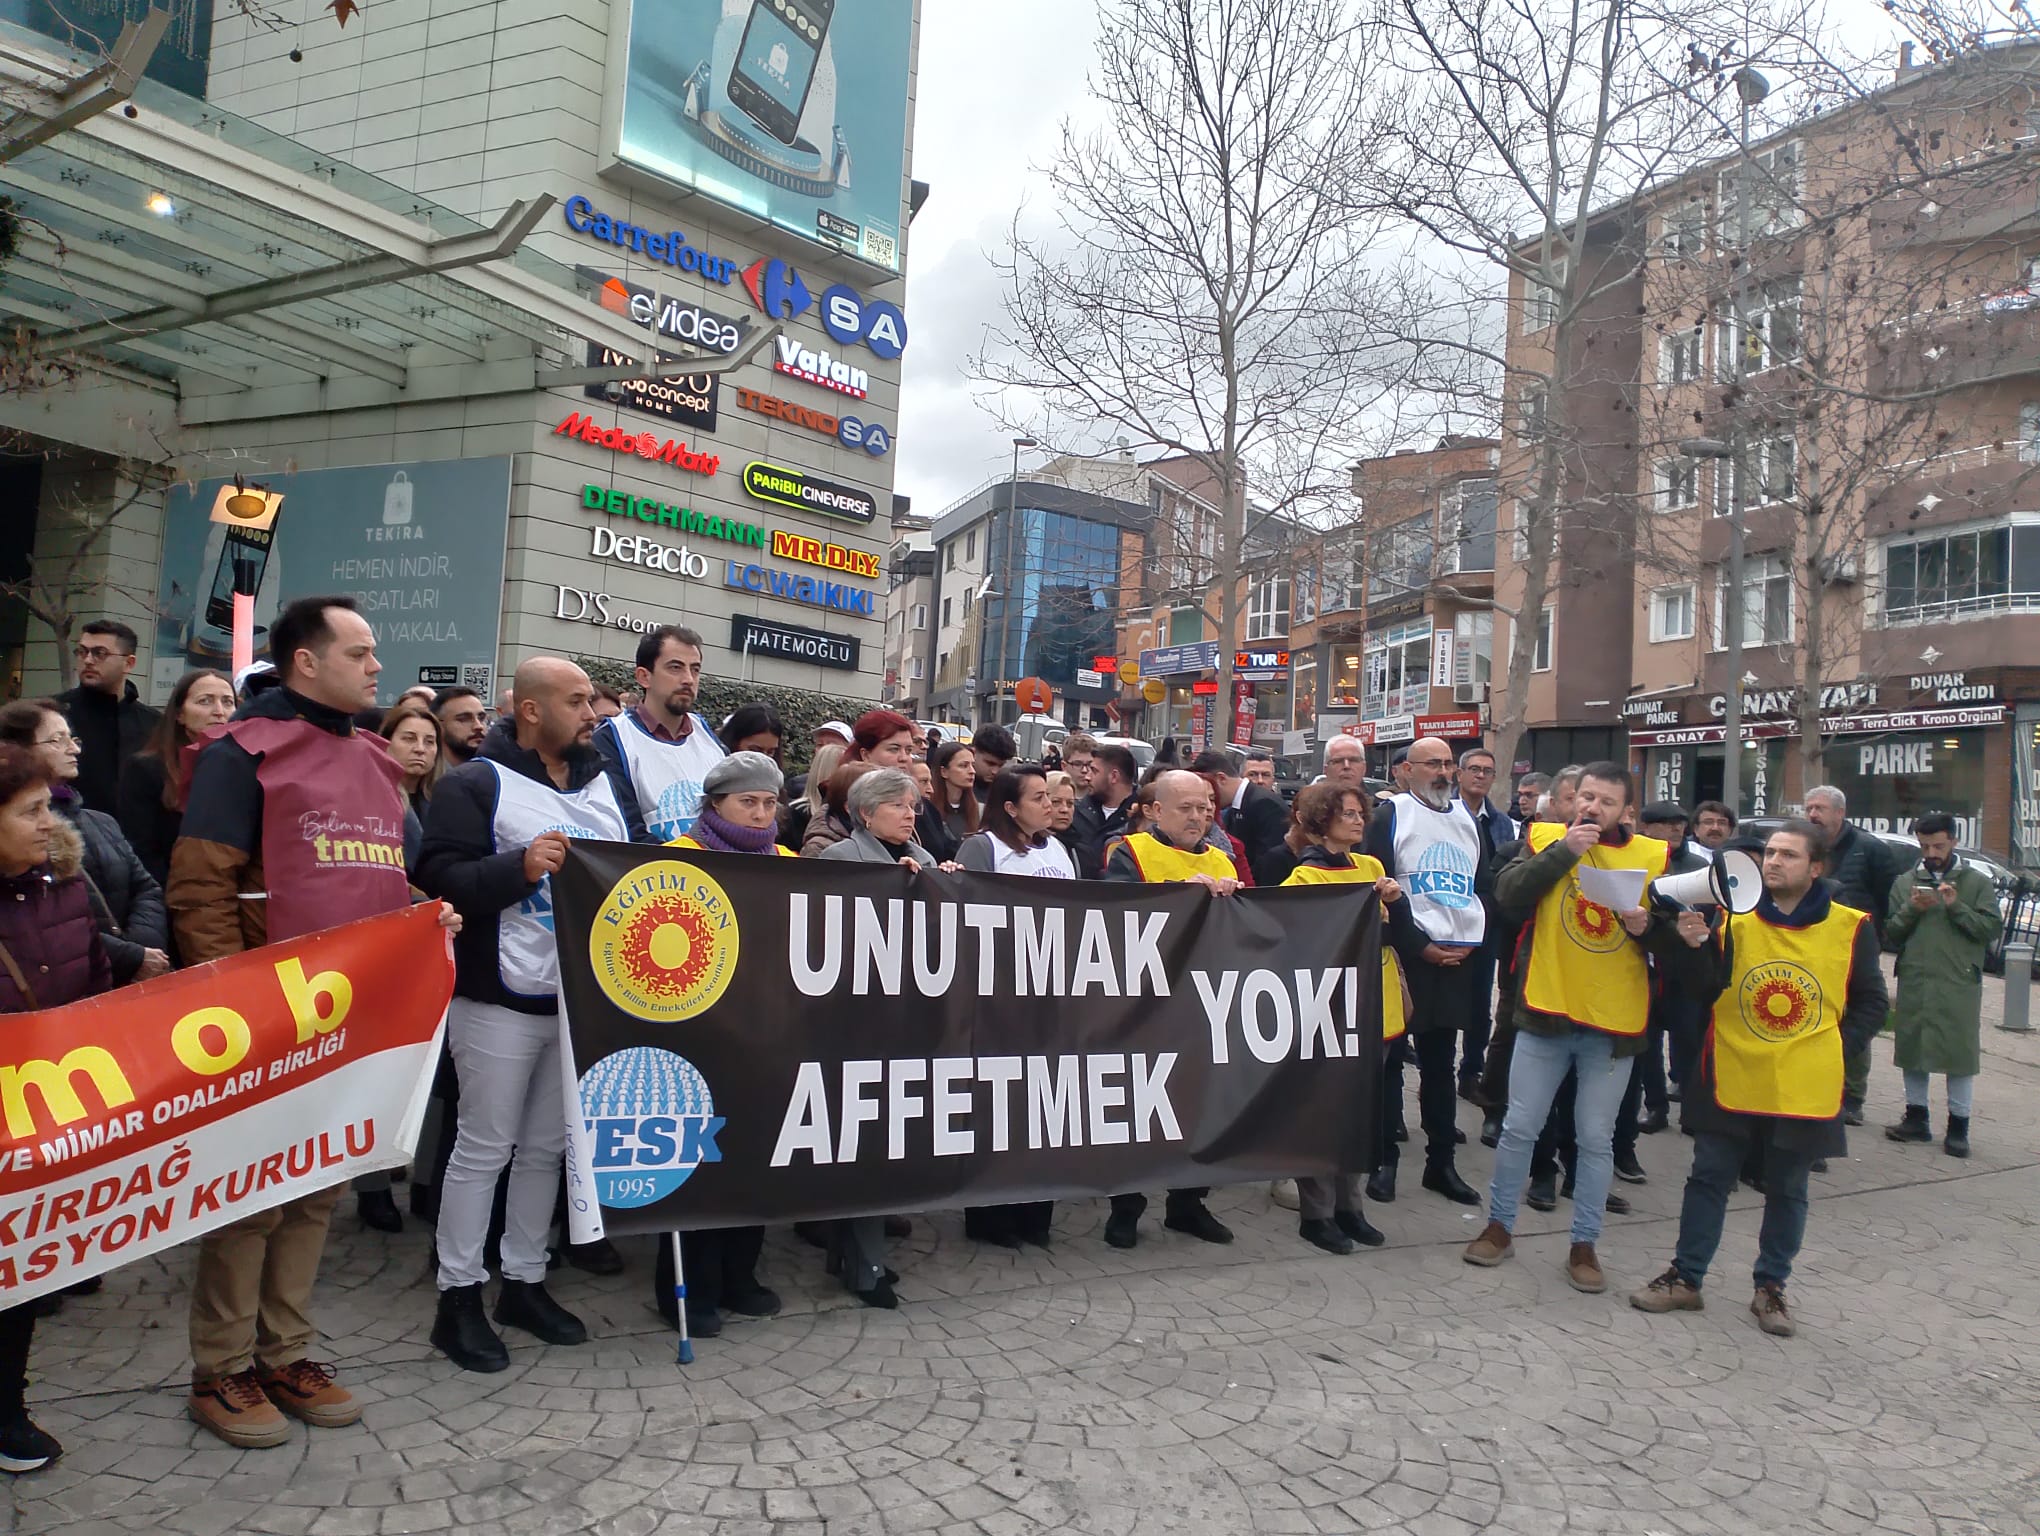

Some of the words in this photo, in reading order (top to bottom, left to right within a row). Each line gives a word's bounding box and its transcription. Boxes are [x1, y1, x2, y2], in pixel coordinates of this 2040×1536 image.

[565, 195, 737, 285] Carrefour
[830, 293, 903, 350] SA
[630, 293, 739, 351] evidea
[776, 334, 868, 391] Vatan
[648, 383, 710, 412] concept
[782, 364, 861, 397] COMPUTER
[635, 396, 673, 414] HOME
[555, 411, 637, 453] Media
[656, 438, 720, 476] Markt
[583, 484, 766, 549] DEICHMANN
[332, 559, 394, 580] HEMEN
[399, 551, 453, 579] İNDİR,
[591, 526, 708, 578] DeFacto
[727, 559, 764, 593] LC
[556, 585, 611, 625] D'S
[388, 620, 463, 642] YAKALA.
[746, 628, 850, 663] HATEMOĞLU
[1910, 673, 1965, 690] DUVAR
[1646, 711, 1679, 725] PARKE
[1710, 689, 1796, 717] CNAY
[1861, 718, 1888, 729] Terra
[1890, 715, 1917, 728] Click
[1922, 713, 1956, 724] Krono
[1958, 709, 2002, 724] Orginal
[1656, 731, 1706, 744] CANAY
[1717, 728, 1754, 740] YPI
[1858, 742, 1934, 776] PARKE
[603, 870, 688, 927] EĞİTİM
[693, 885, 732, 931] SEN
[788, 892, 1172, 998] UNUTMAK
[622, 988, 648, 1009] Bilim
[650, 992, 706, 1013] Emekçileri
[1190, 966, 1360, 1064] YOK!
[39, 1110, 145, 1168] MİMAR
[152, 1067, 262, 1124] ODALARI
[268, 1027, 347, 1082] BİRLİĞİ
[769, 1052, 1184, 1168] AFFETMEK
[584, 1116, 727, 1168] ESK
[188, 1118, 376, 1220] KURULU
[607, 1175, 656, 1202] 1995
